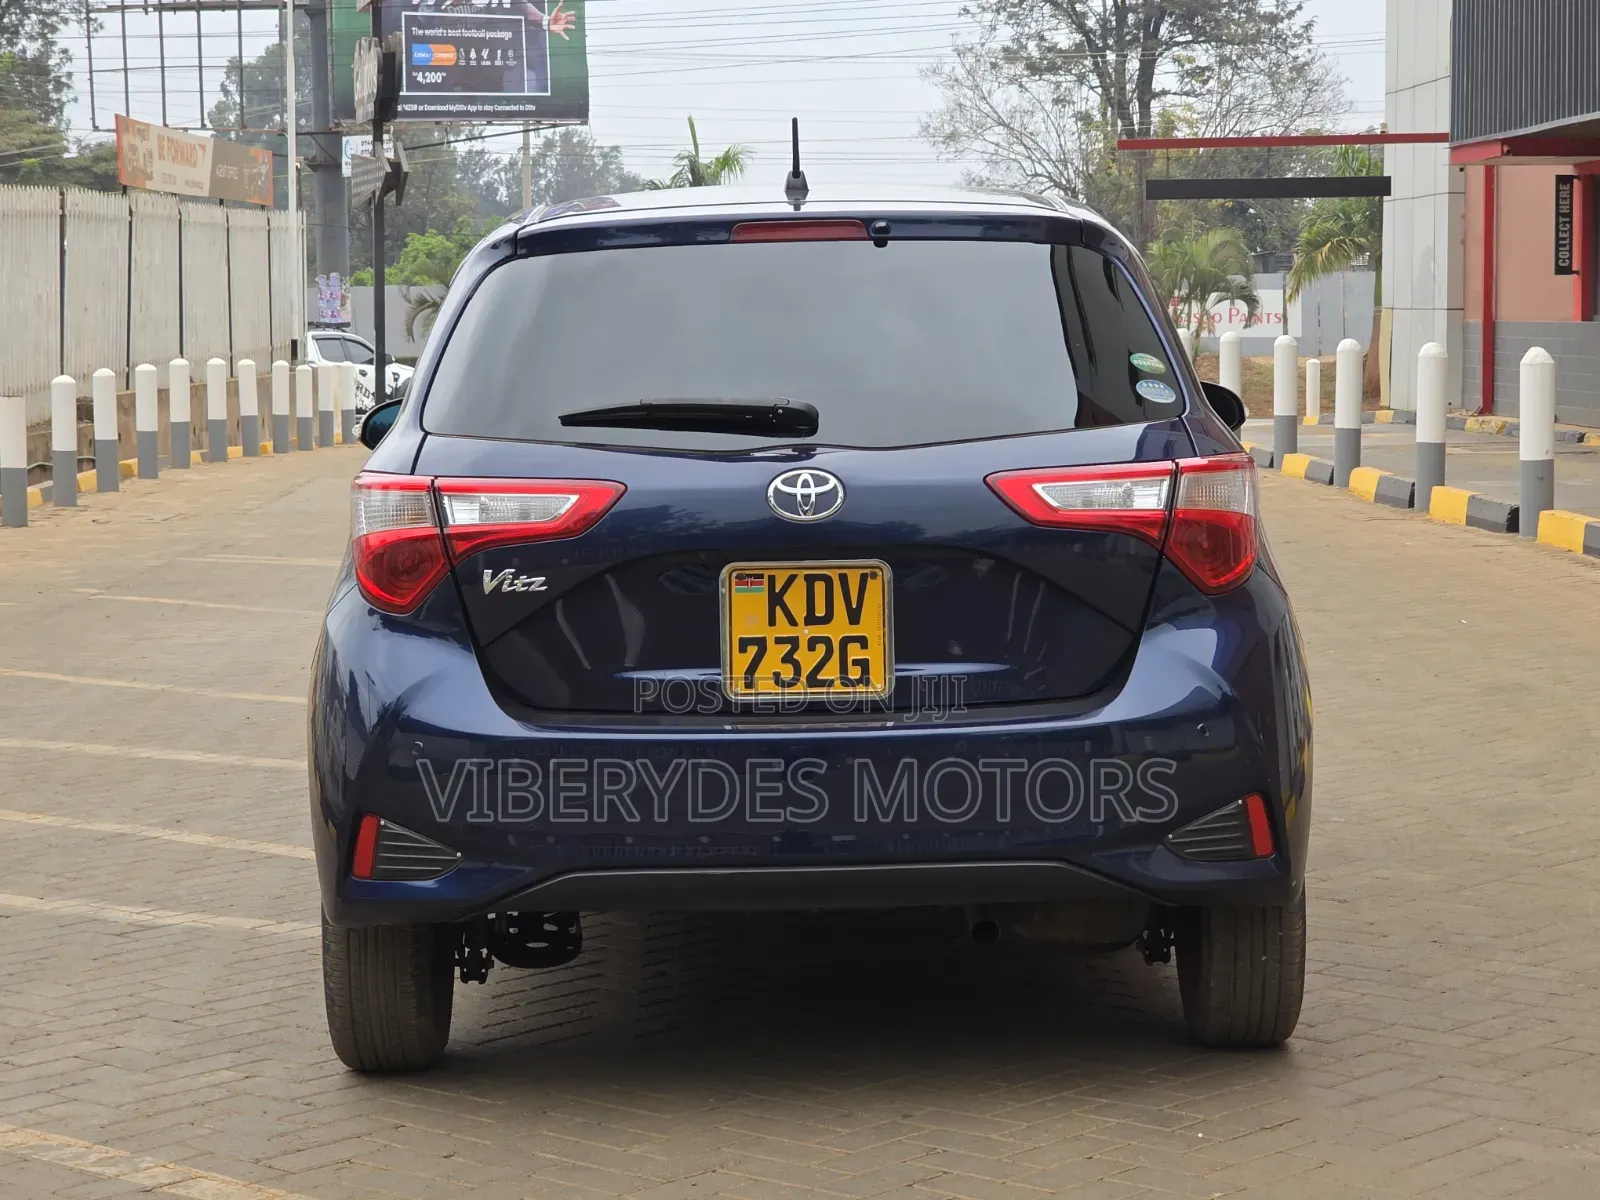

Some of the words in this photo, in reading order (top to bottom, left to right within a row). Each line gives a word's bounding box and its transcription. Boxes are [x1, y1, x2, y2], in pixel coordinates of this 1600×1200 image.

[411, 27, 424, 36] The
[424, 28, 447, 37] world's
[448, 29, 461, 37] best
[462, 29, 486, 38] football
[486, 31, 513, 40] package
[417, 71, 443, 84] 4,200
[1559, 183, 1571, 213] HERE
[1558, 216, 1571, 267] COLLECT
[483, 568, 548, 595] Vitz
[767, 572, 870, 627] KDV
[738, 635, 871, 689] 732G
